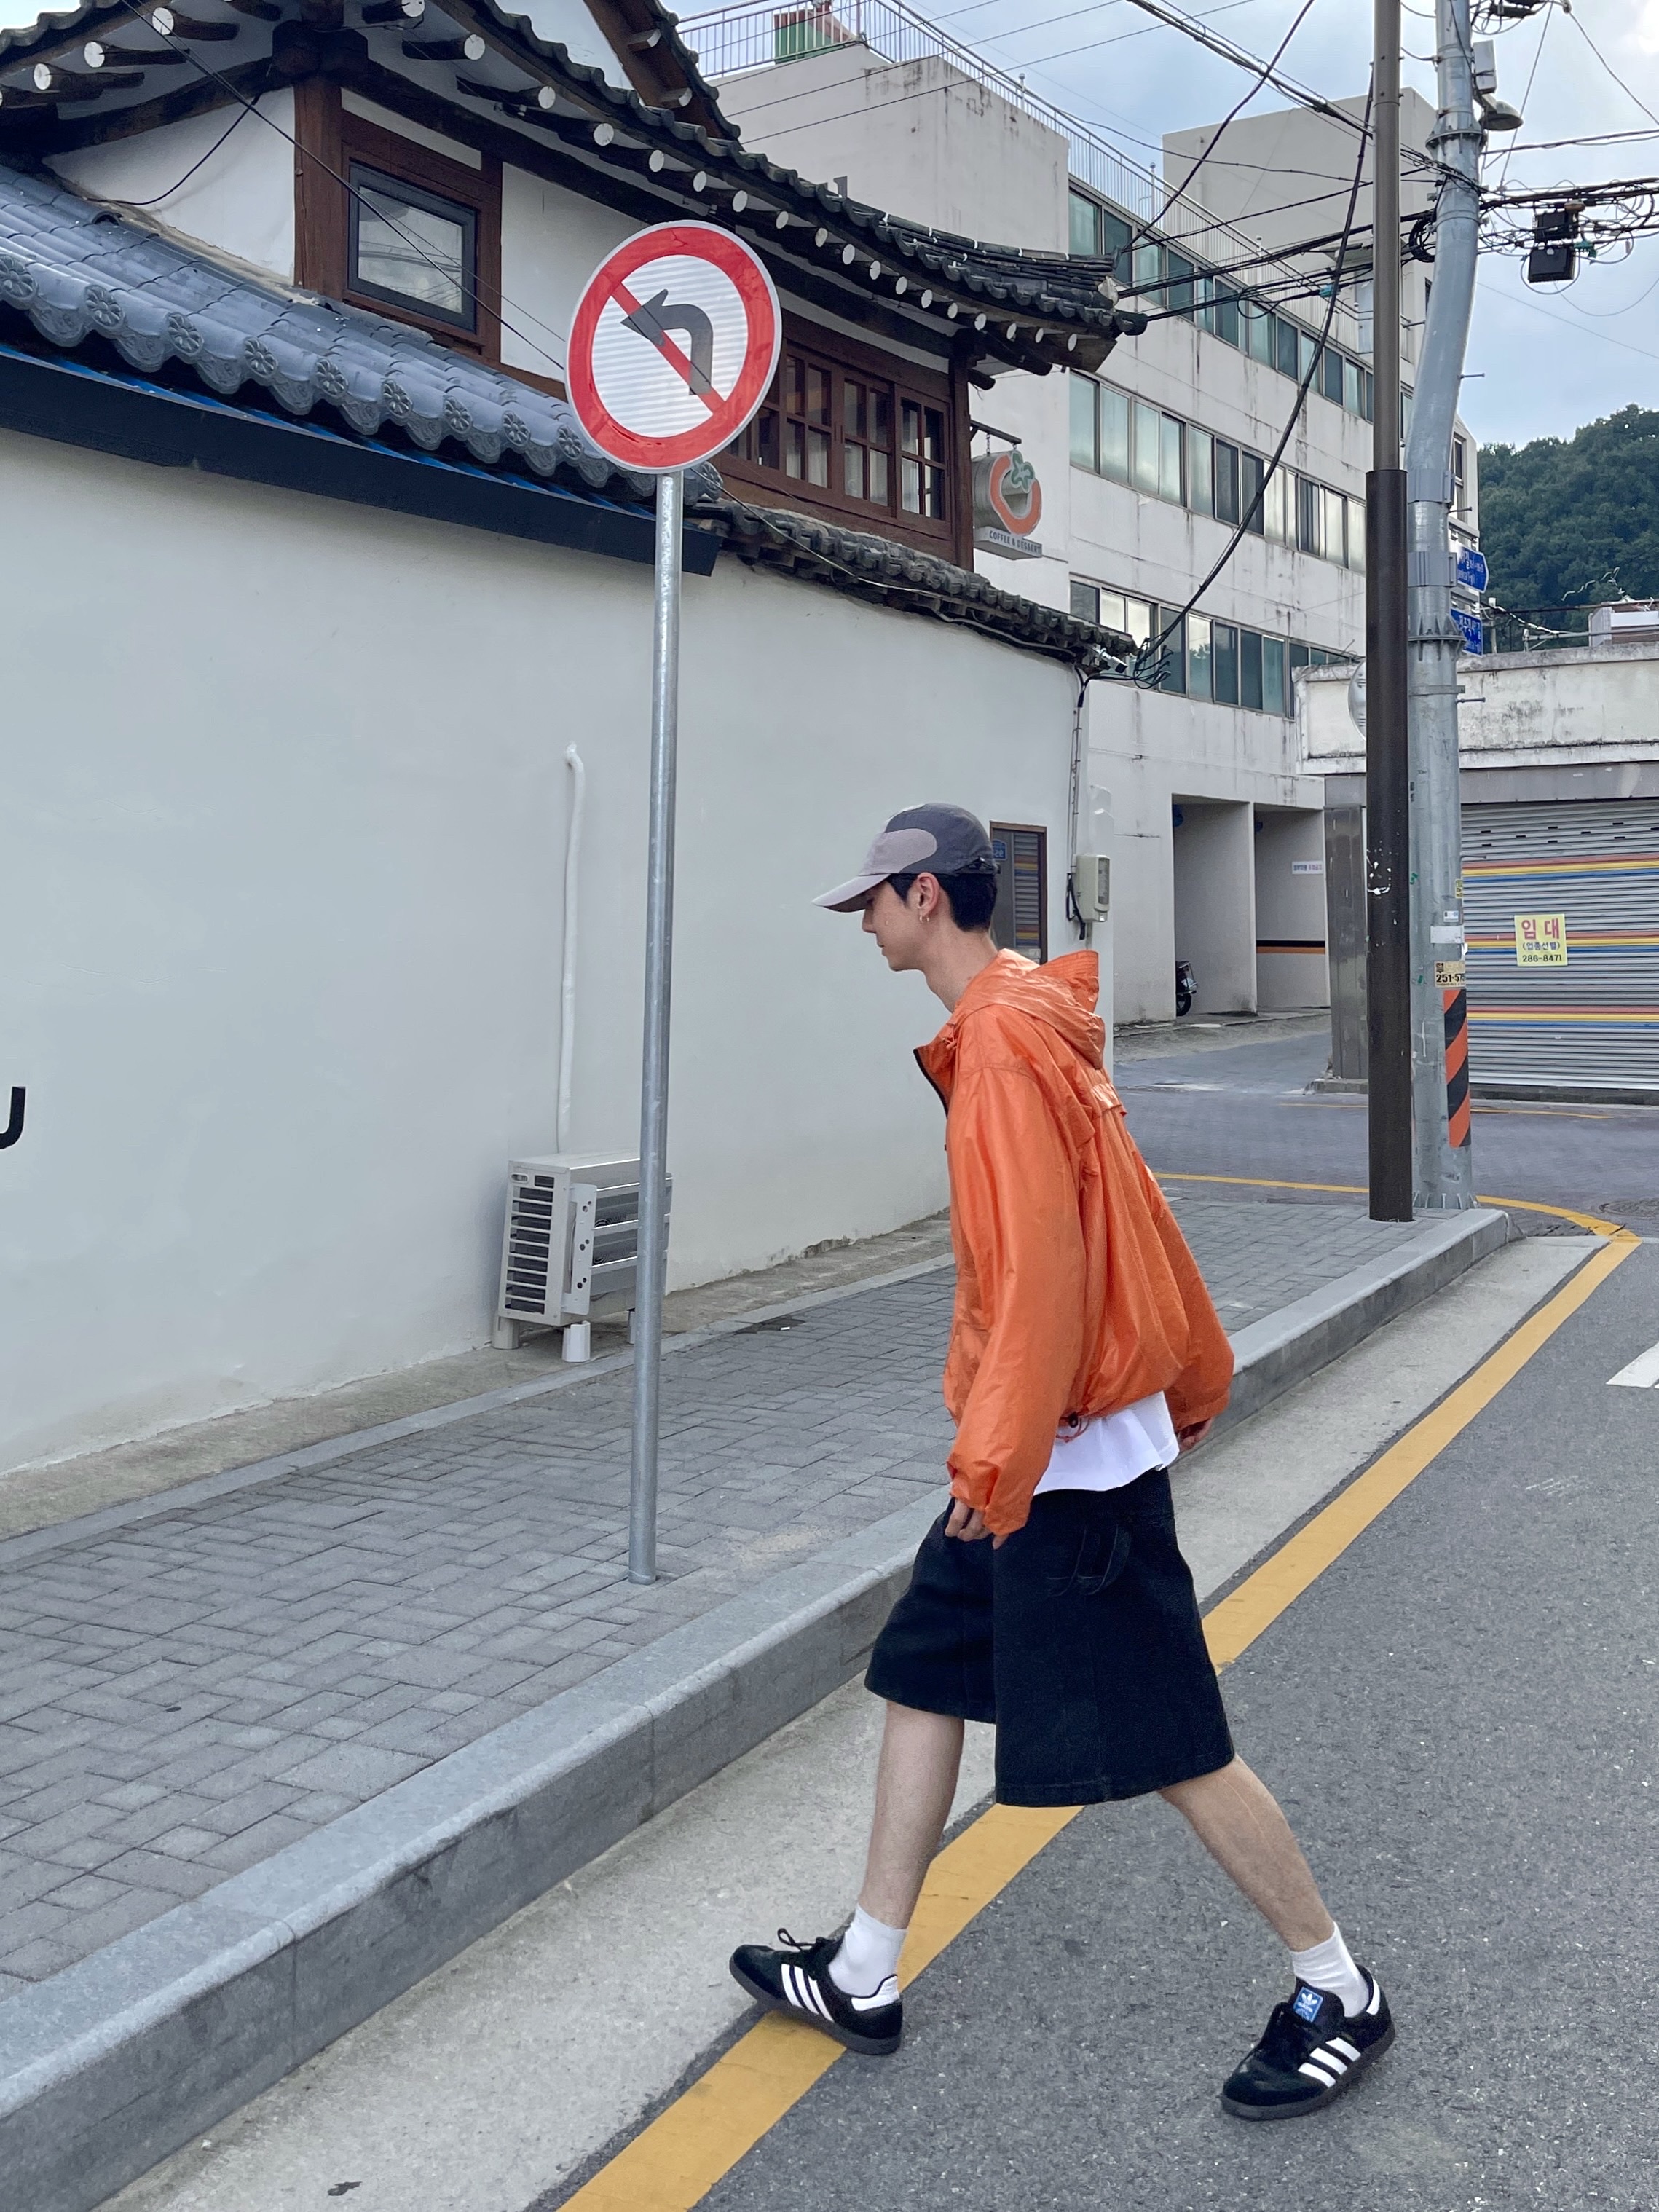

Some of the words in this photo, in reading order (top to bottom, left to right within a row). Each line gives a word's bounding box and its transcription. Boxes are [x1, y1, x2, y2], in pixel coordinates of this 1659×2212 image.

[989, 530, 1010, 544] COFFEE
[1012, 538, 1015, 546] &
[1017, 539, 1041, 554] DESSERT
[1522, 954, 1562, 962] 286-8471
